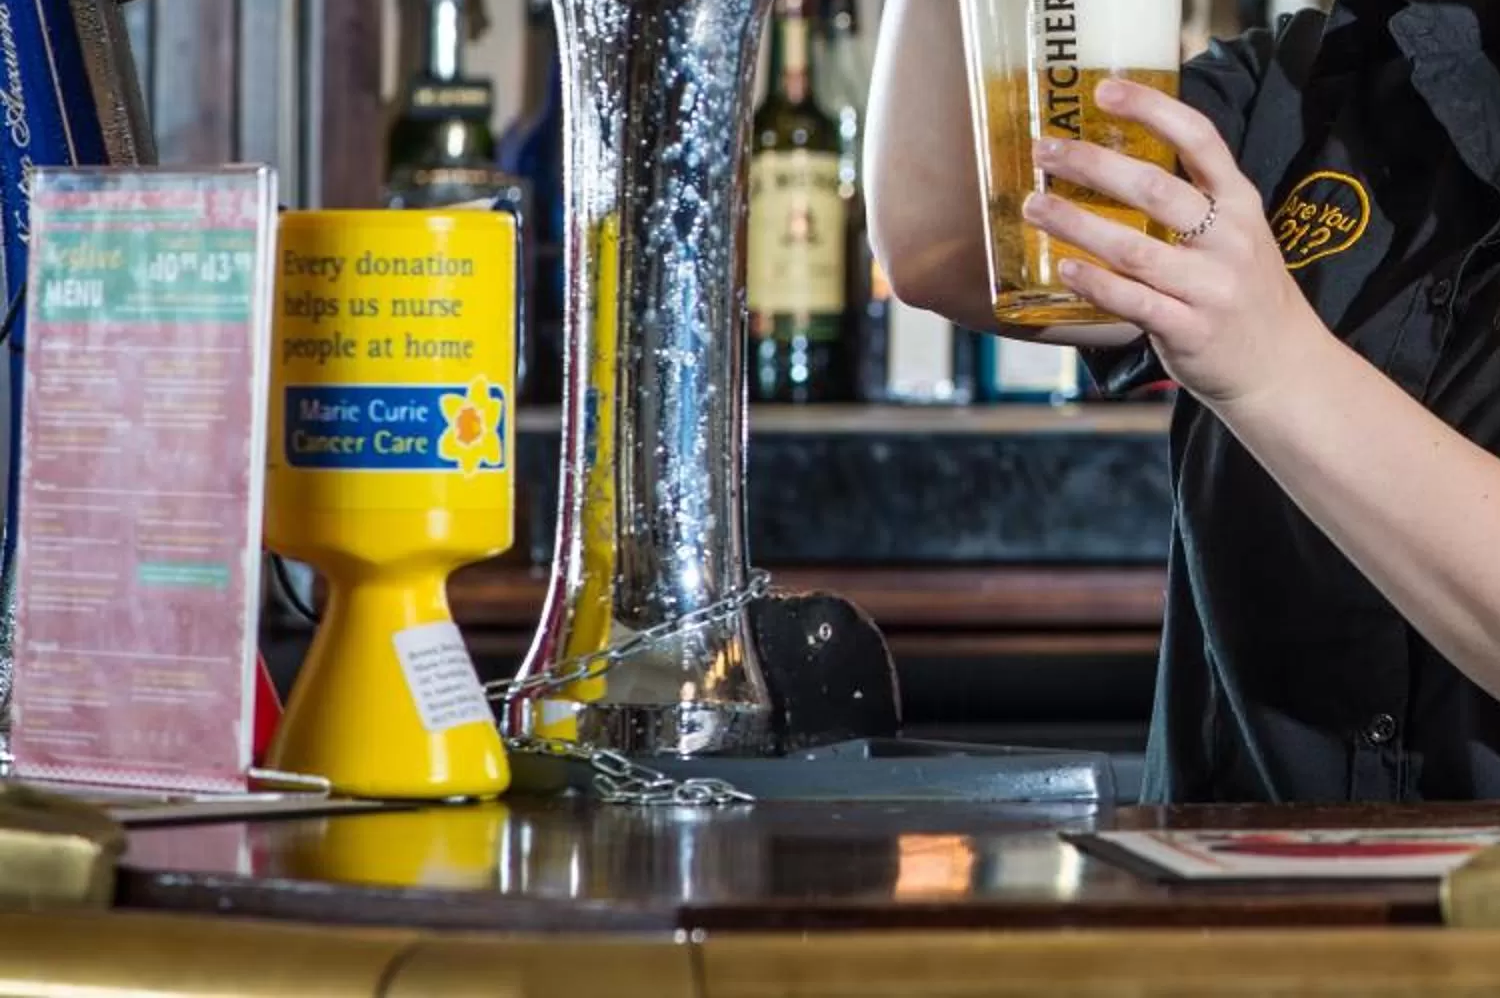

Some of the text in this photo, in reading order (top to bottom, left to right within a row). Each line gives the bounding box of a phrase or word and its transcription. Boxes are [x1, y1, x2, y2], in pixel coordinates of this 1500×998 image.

[1284, 196, 1357, 232] Are You
[284, 250, 474, 282] Every donation
[44, 278, 105, 308] MENU
[283, 291, 464, 323] helps us nurse
[283, 331, 474, 365] people at home
[301, 398, 429, 422] Marie Curie
[292, 430, 429, 454] Cancer Care
